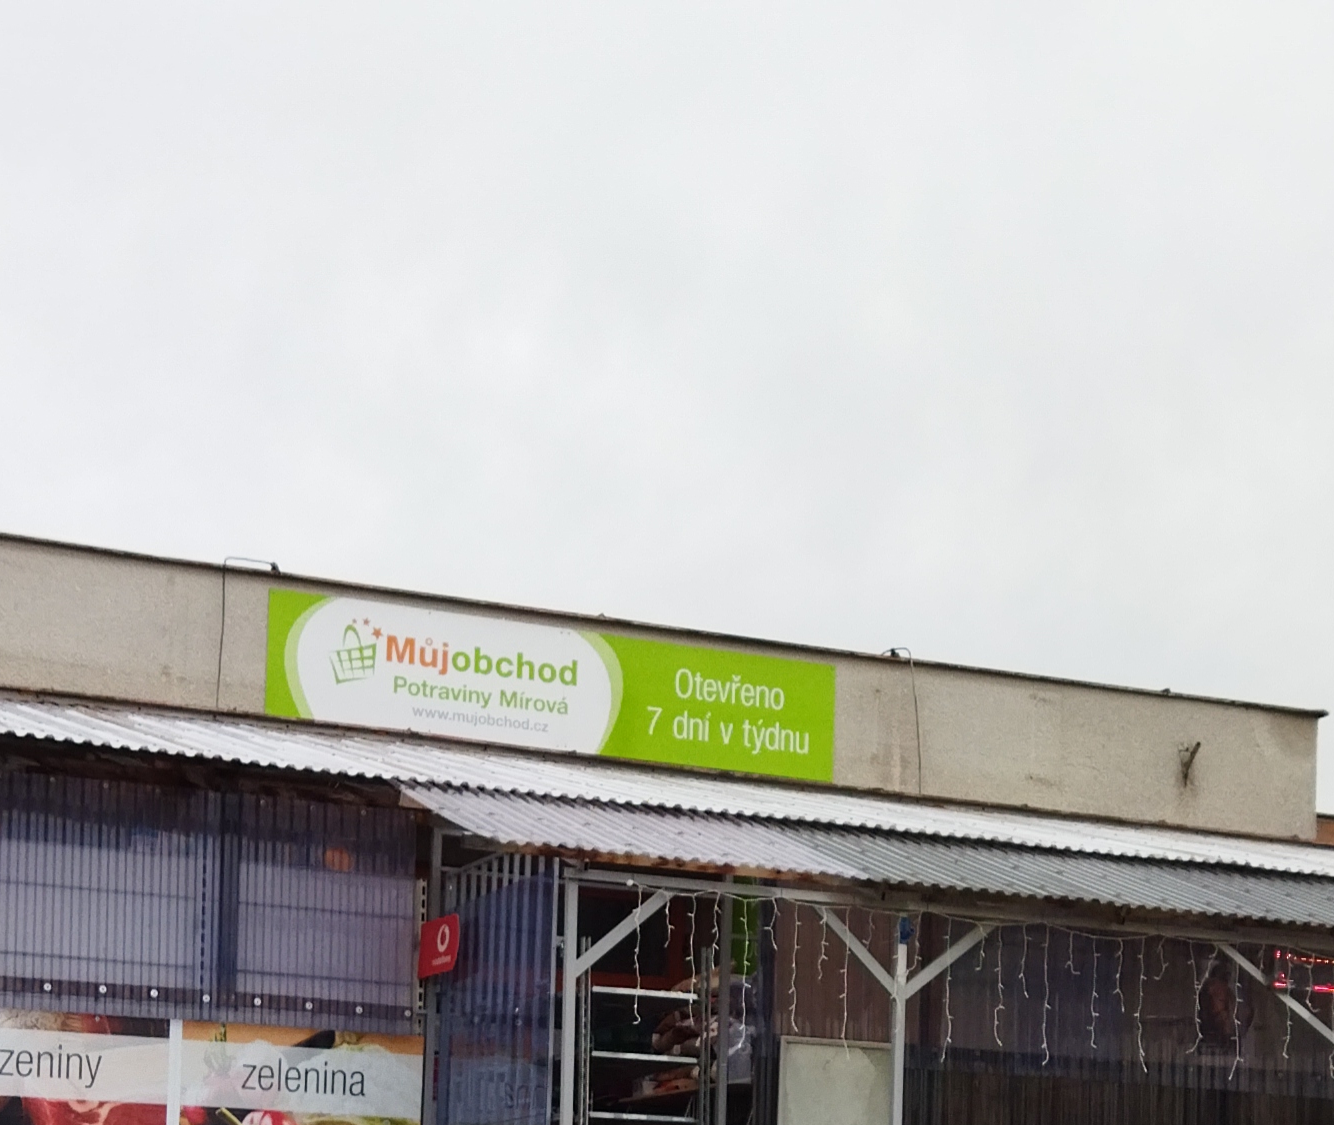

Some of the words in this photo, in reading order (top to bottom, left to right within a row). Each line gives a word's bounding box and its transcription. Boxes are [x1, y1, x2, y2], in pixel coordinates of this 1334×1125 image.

[385, 634, 579, 687] Můjobchod
[393, 675, 492, 709] Potraviny
[499, 689, 569, 716] Mírová
[674, 668, 785, 711] Otevřeno
[411, 705, 549, 733] www.mujobchod.cz
[646, 705, 663, 736] 7
[672, 710, 712, 742] dní
[719, 721, 734, 745] v
[742, 719, 810, 755] týdnu
[241, 1057, 365, 1097] zelenina
